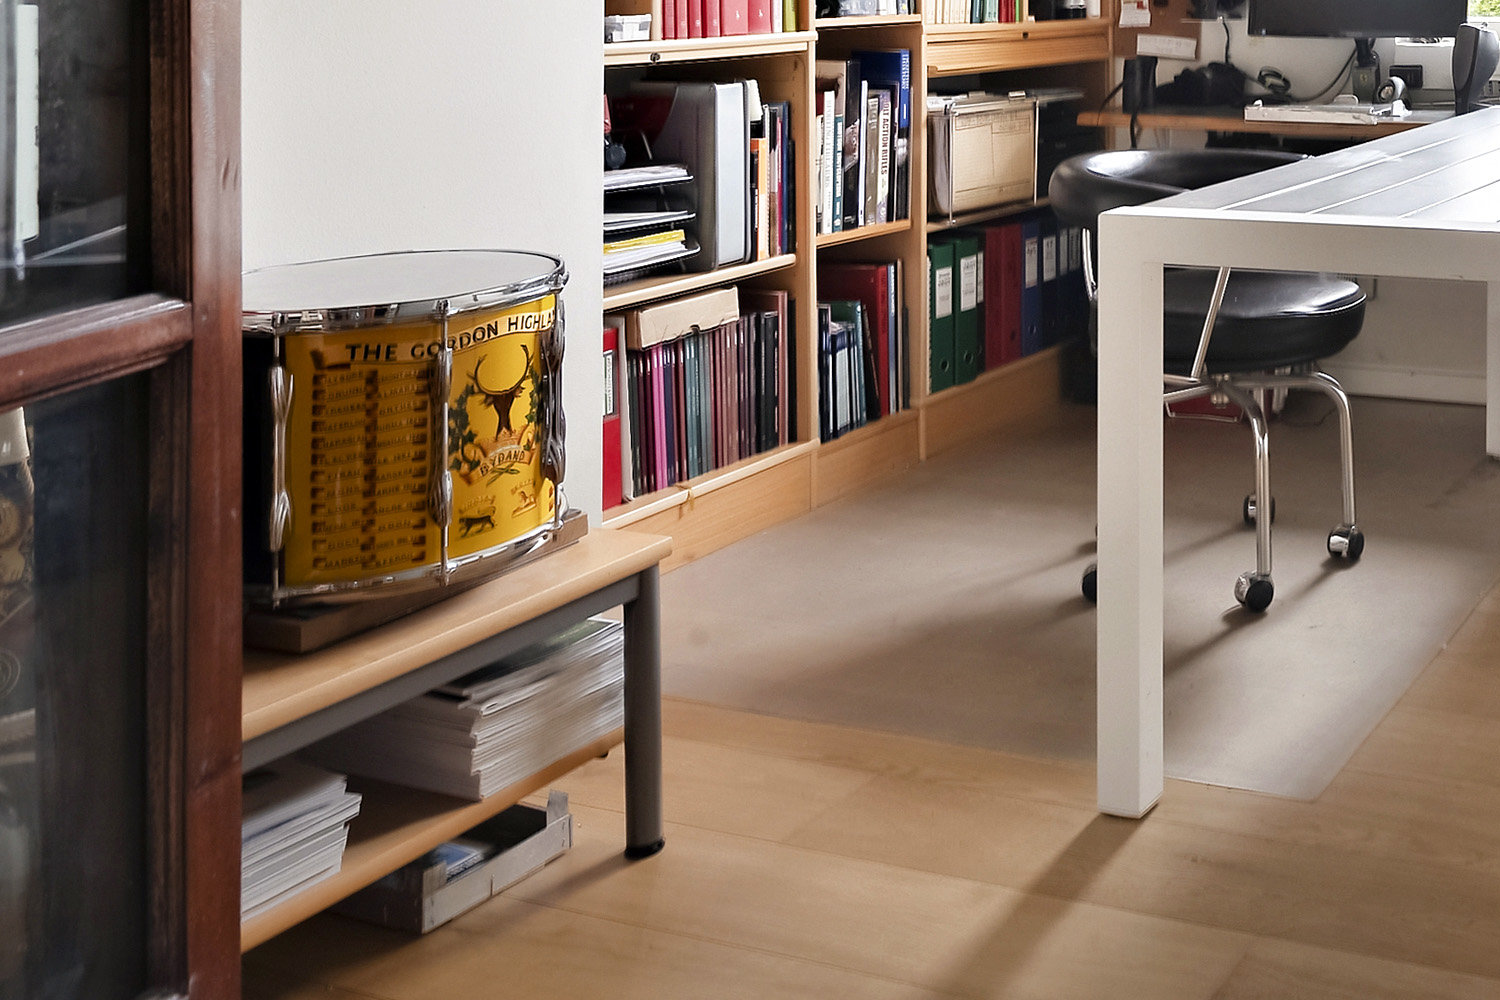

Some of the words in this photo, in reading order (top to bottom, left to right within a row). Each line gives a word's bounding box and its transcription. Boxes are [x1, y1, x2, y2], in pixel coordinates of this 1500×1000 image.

[881, 118, 889, 148] ACTION
[880, 149, 888, 175] RIFLES
[345, 342, 398, 362] THE
[410, 320, 499, 361] GORDON
